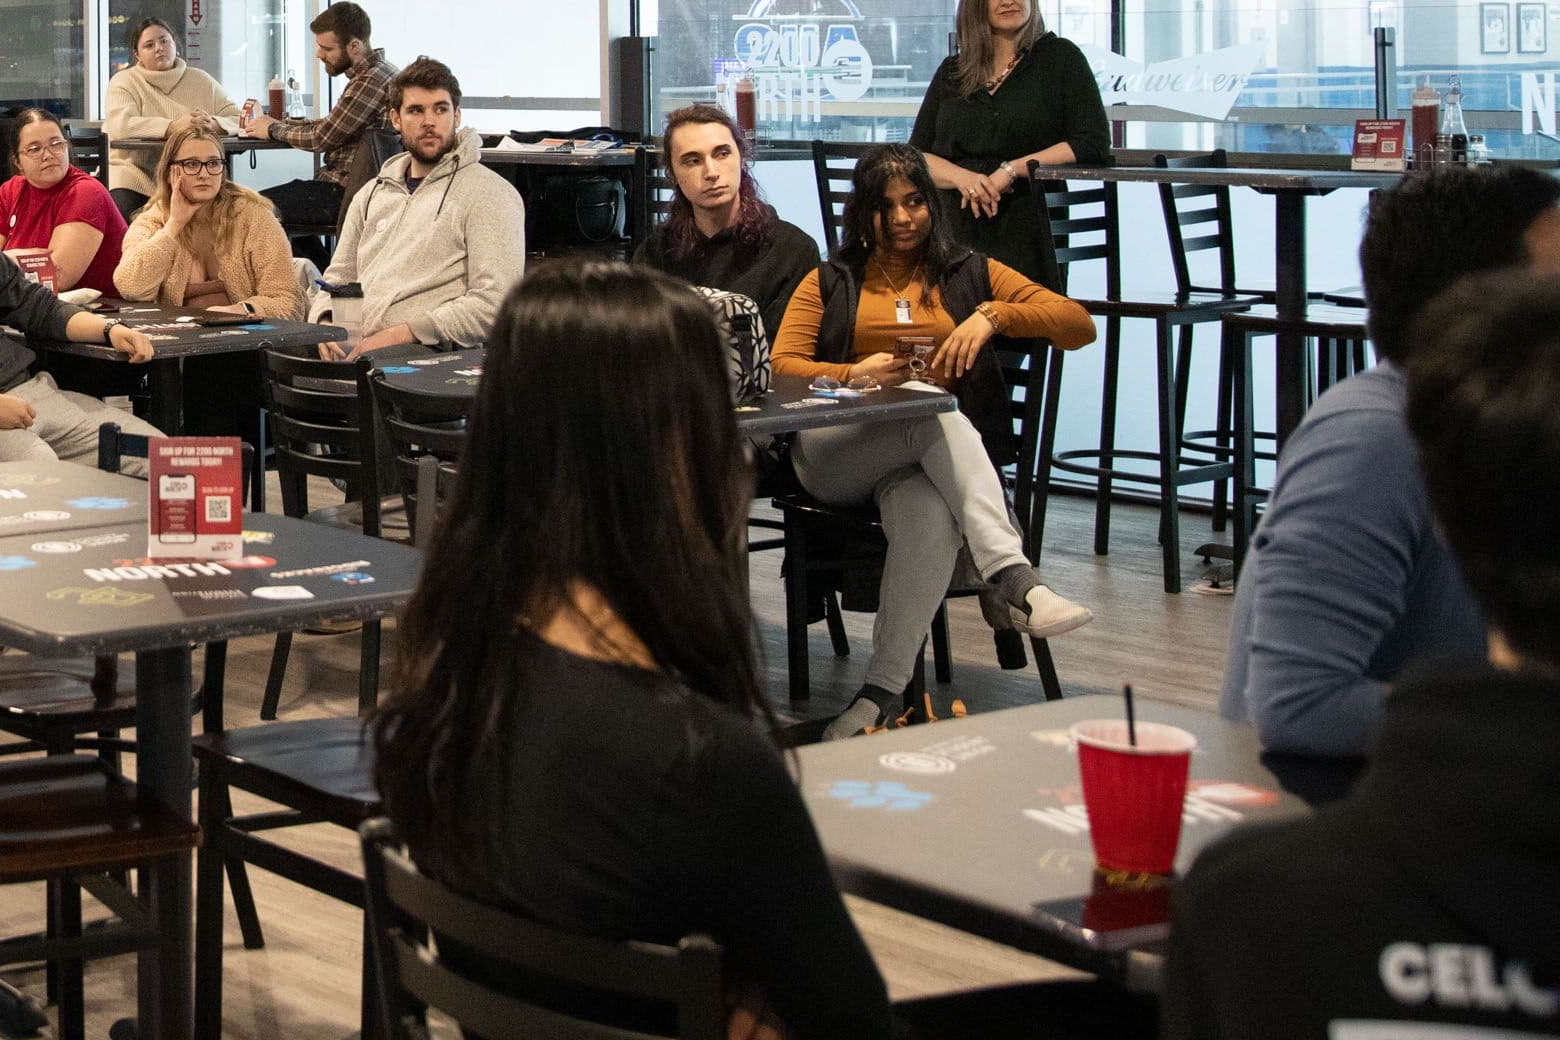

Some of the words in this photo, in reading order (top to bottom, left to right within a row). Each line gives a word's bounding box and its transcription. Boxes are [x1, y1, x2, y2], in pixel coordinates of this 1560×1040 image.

[747, 30, 821, 68] 2200
[1095, 64, 1256, 94] udweiser
[716, 72, 821, 123] NRTH
[82, 562, 232, 583] NORTH
